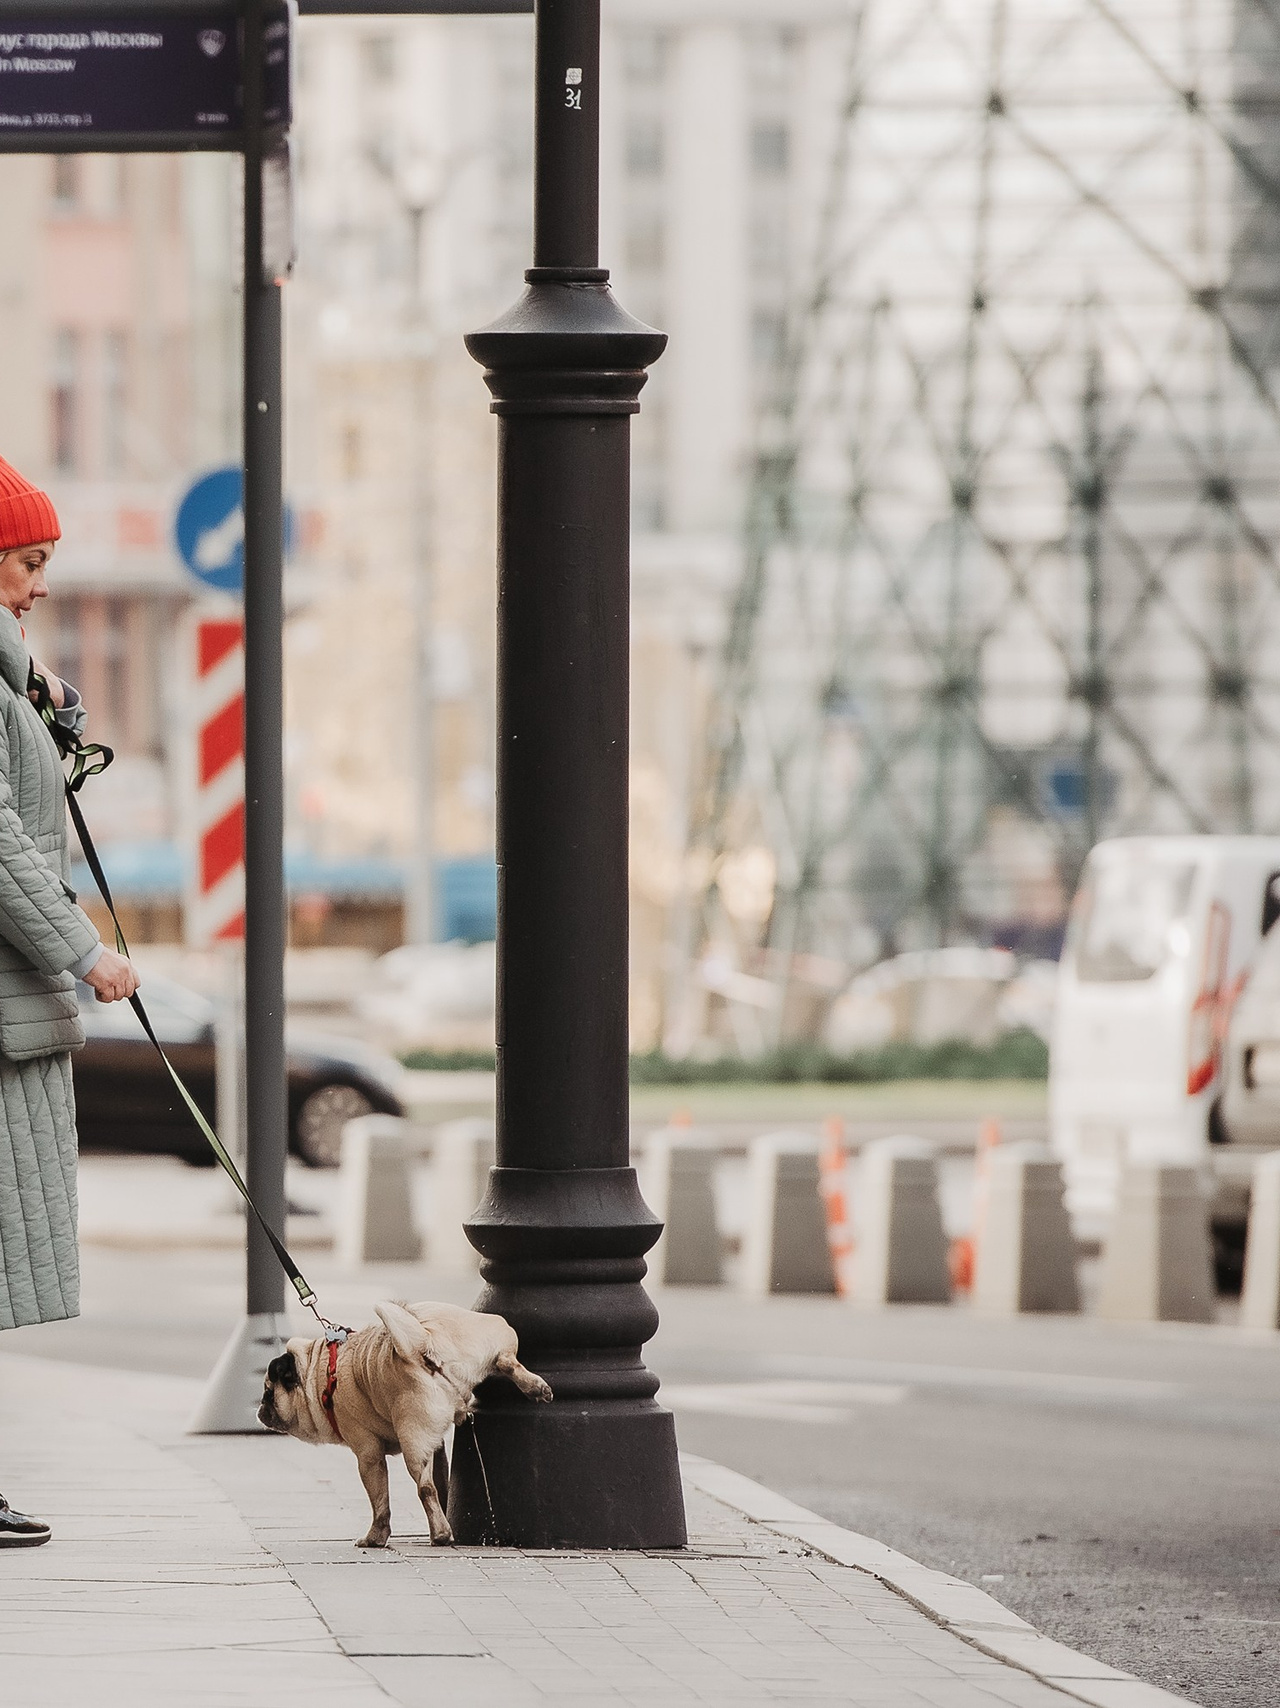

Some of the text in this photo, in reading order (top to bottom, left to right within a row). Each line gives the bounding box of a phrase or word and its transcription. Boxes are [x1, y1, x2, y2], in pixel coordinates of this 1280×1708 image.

[25, 33, 90, 52] города
[91, 30, 163, 48] Москвы
[12, 57, 76, 72] Moscow
[564, 87, 582, 110] 31
